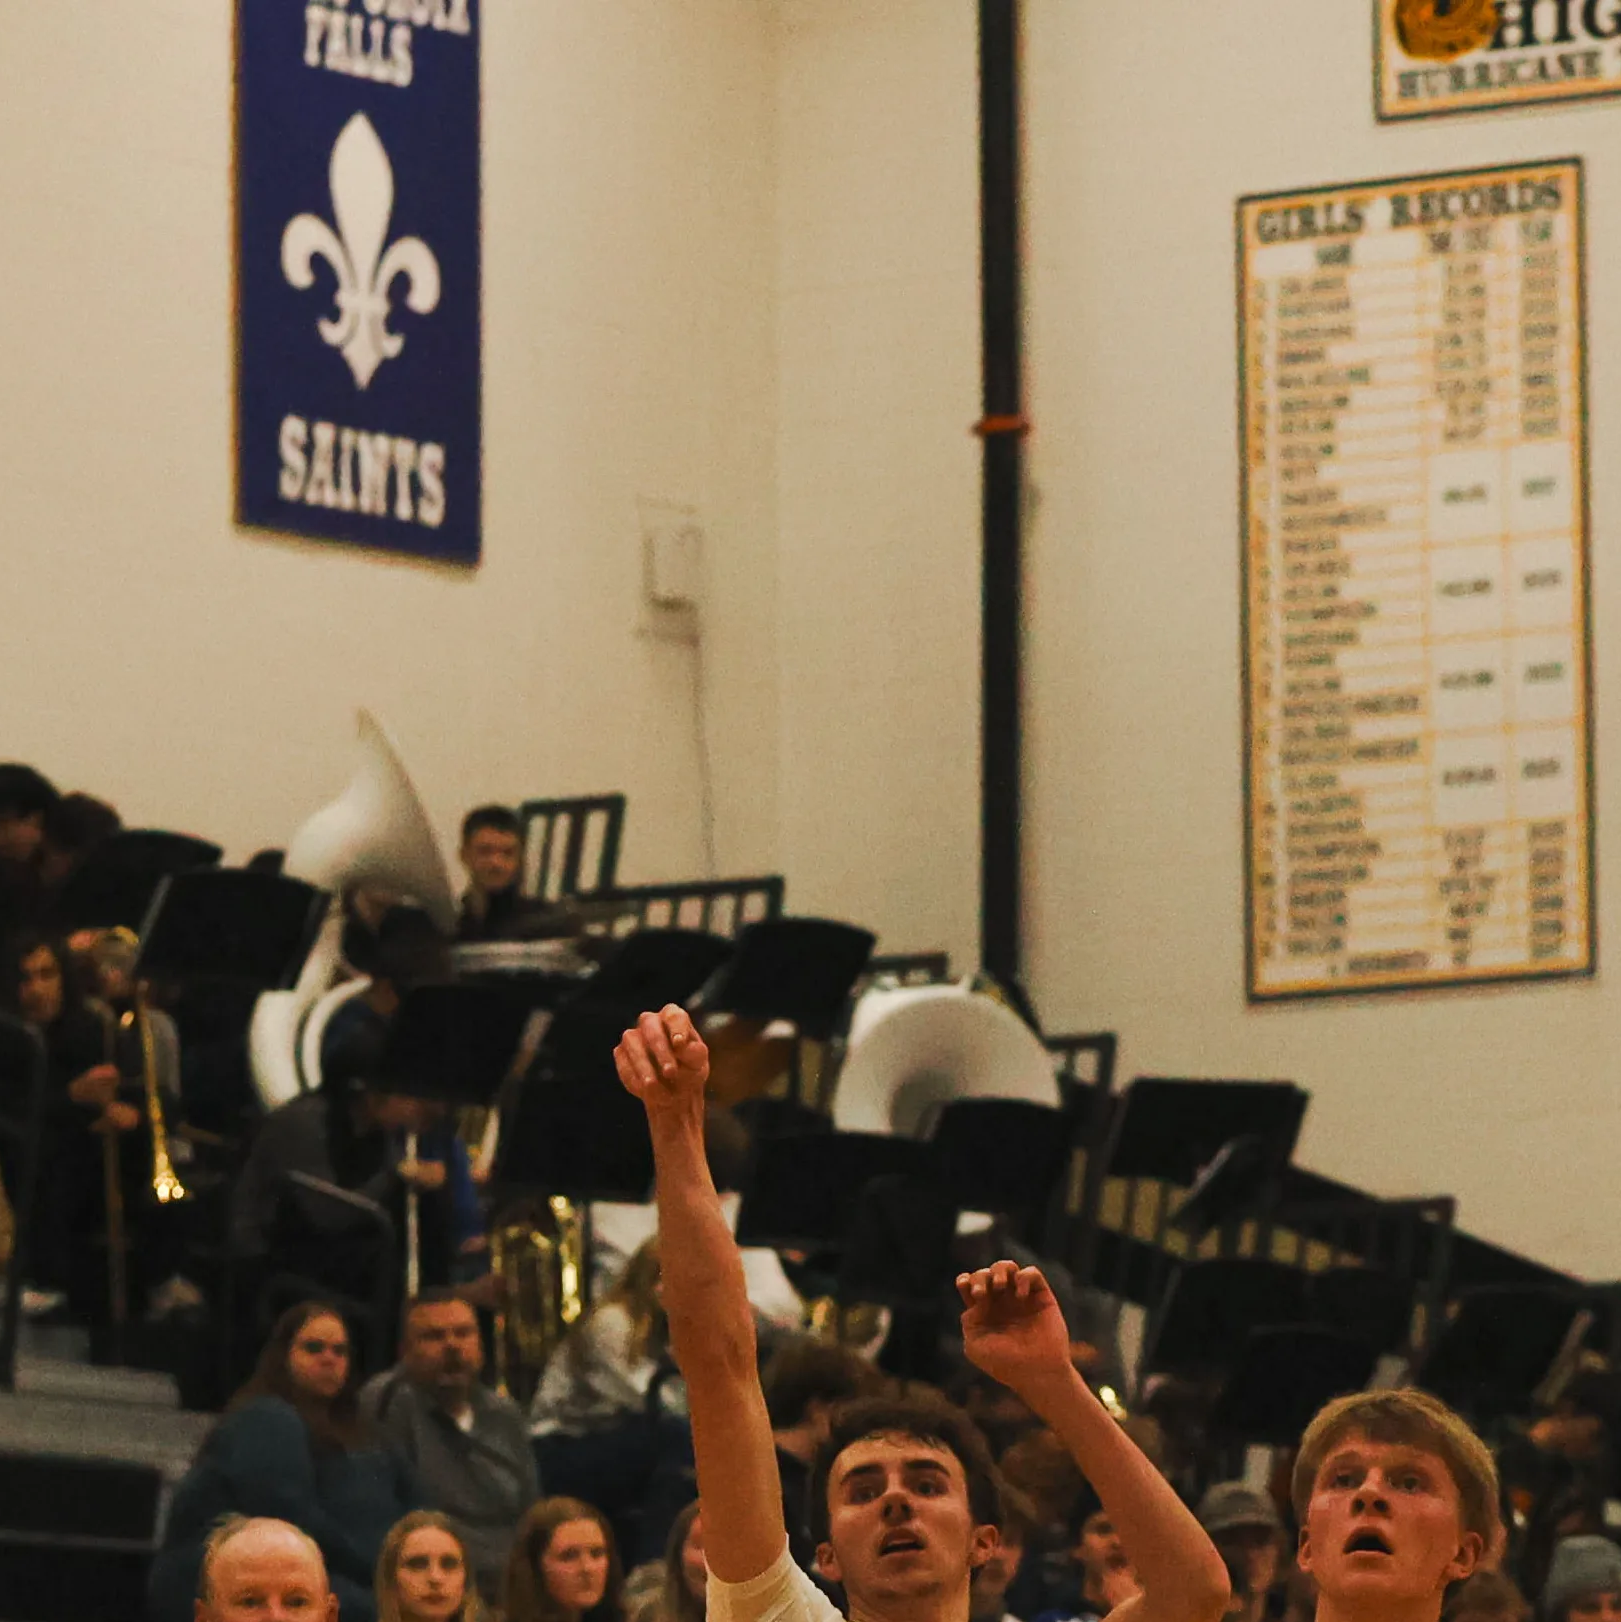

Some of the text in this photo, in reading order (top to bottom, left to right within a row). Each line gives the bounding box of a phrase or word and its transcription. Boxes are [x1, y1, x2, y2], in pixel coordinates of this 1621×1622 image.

[304, 4, 413, 88] FALLS
[1398, 51, 1602, 99] HURRICANE
[1257, 174, 1563, 245] GIRLS RECORDS
[280, 414, 446, 529] SAINTS
